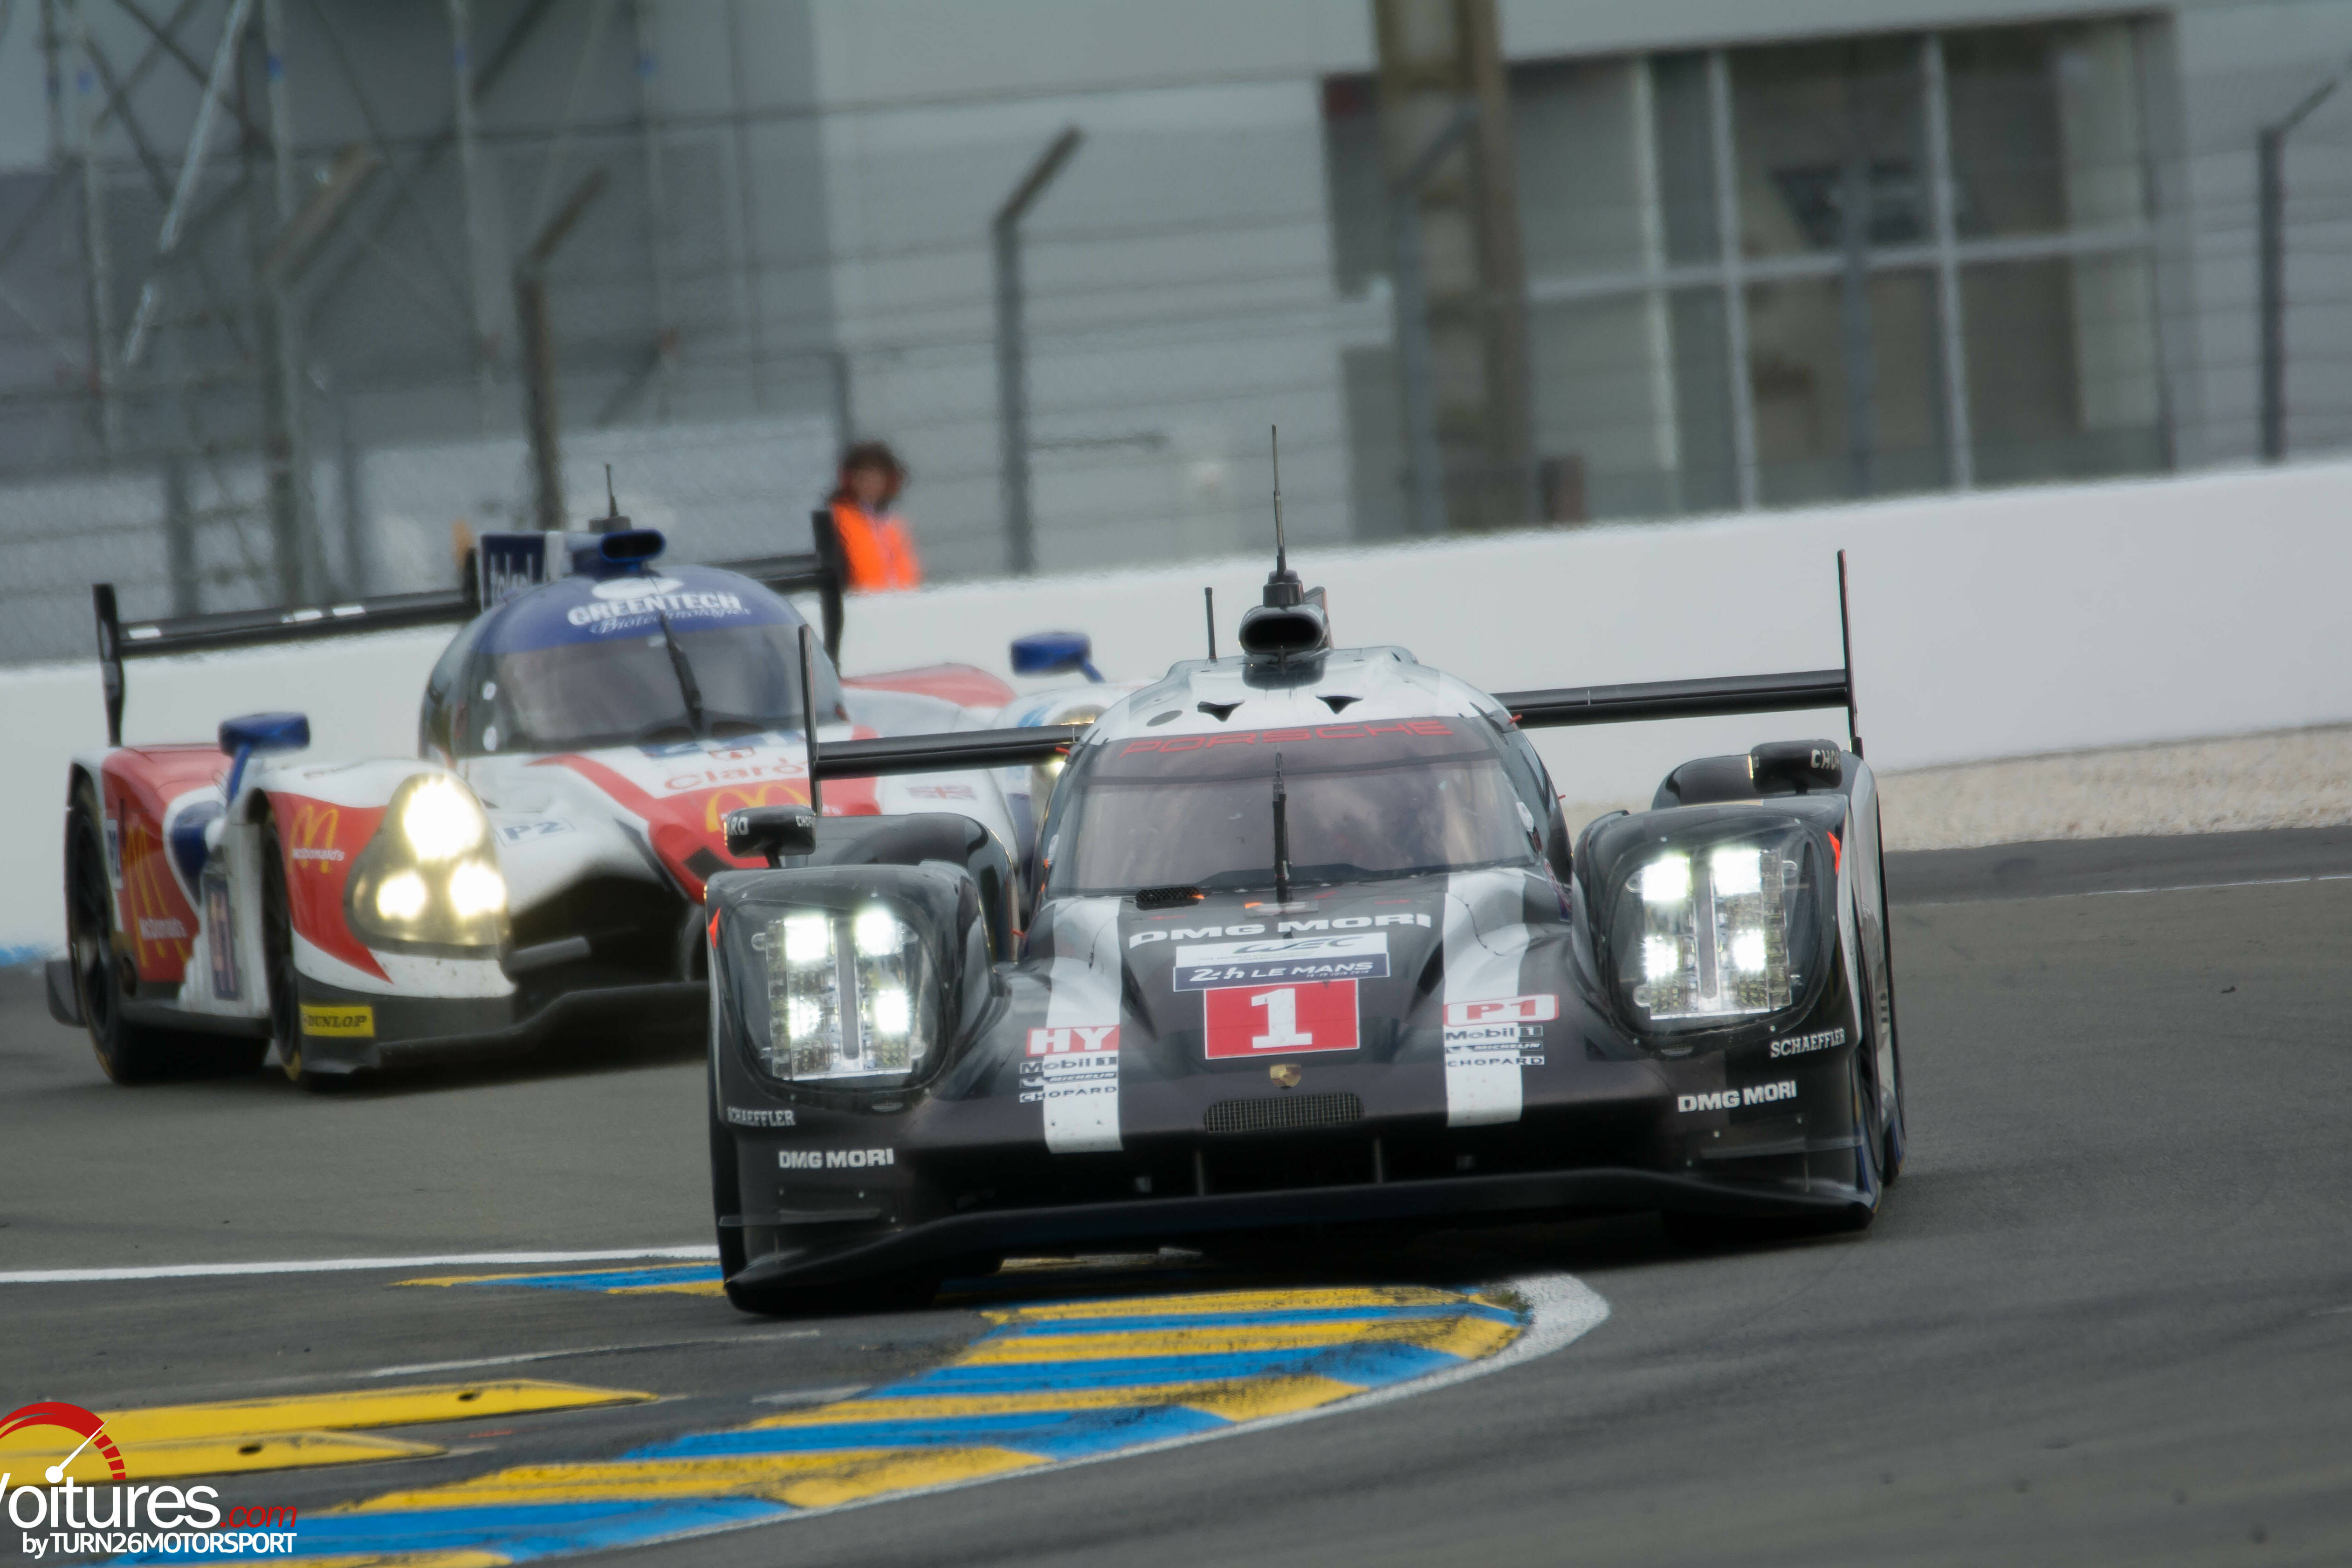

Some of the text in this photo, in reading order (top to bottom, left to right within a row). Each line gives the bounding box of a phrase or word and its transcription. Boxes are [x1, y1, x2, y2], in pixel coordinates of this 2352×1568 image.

[567, 593, 743, 625] GREENTECH
[1119, 720, 1453, 758] PORSCHE
[504, 822, 564, 842] P2
[1129, 913, 1431, 949] DMG MORI
[1251, 968, 1286, 977] LE
[1292, 962, 1374, 975] MANS
[1251, 988, 1313, 1049] 1
[1467, 999, 1536, 1020] P1
[308, 1014, 367, 1028] DUNLOP
[1030, 1027, 1115, 1055] HY
[1445, 1027, 1515, 1040] Mobil
[1770, 1028, 1846, 1058] SCHAEFFLER
[1022, 1058, 1091, 1073] Mobil
[1447, 1057, 1543, 1067] CHOPARD
[1022, 1087, 1117, 1101] CHOPARD
[1678, 1080, 1797, 1113] DMG MORI
[779, 1148, 894, 1169] DMG MORI
